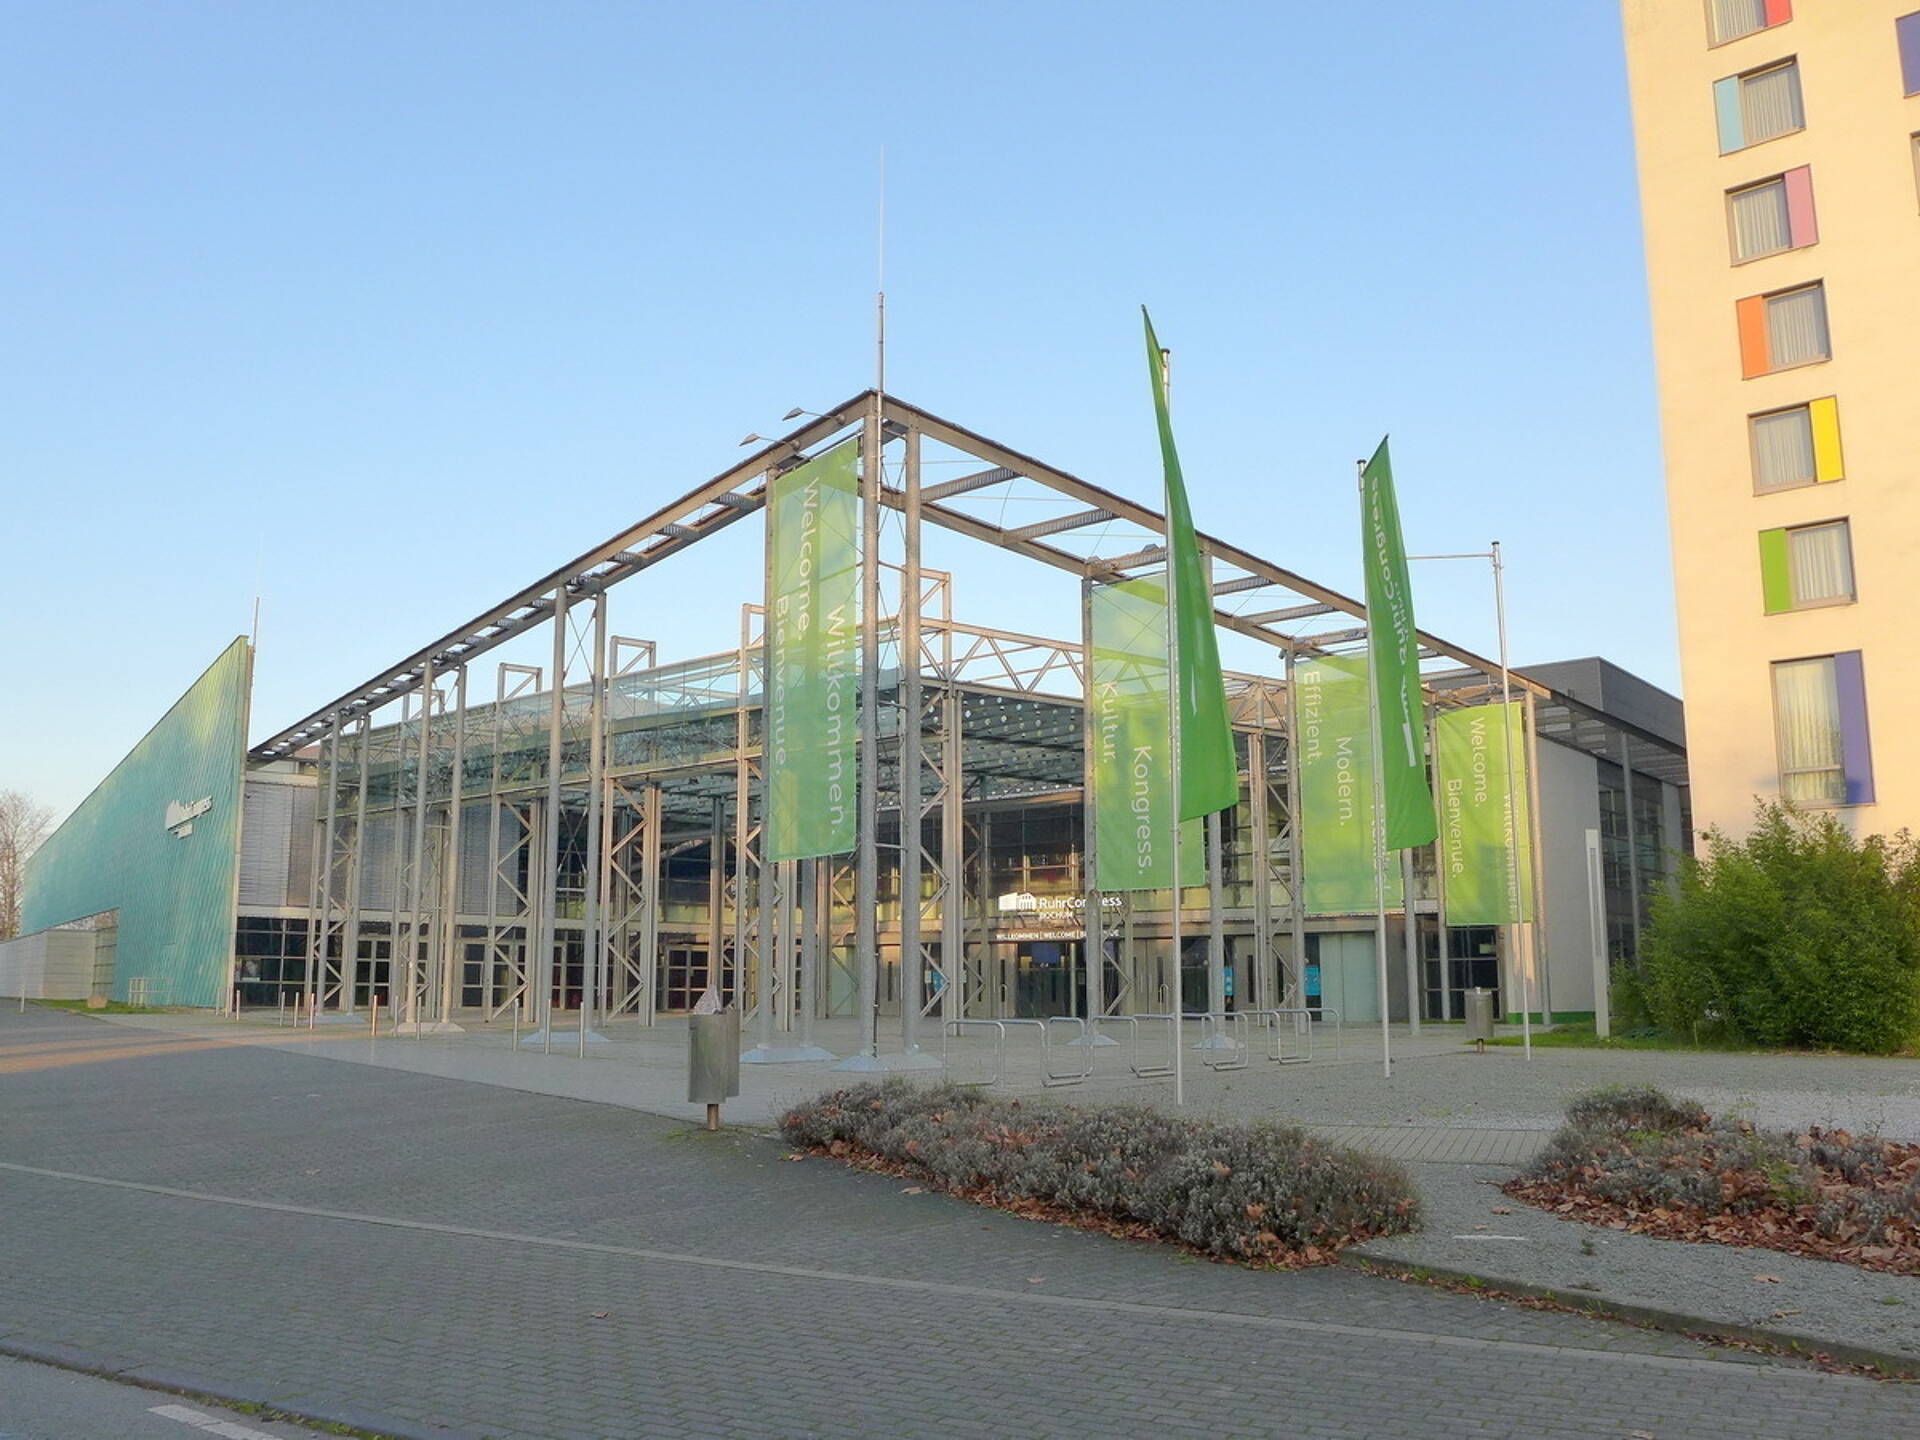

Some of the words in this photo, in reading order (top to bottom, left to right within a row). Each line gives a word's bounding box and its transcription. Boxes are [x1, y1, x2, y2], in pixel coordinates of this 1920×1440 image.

[798, 476, 819, 640] Welcome.
[775, 594, 788, 775] Bienvenue.
[826, 604, 845, 835] Willkommen.
[1102, 681, 1118, 763] Kultur.
[1303, 671, 1322, 765] Effizient.
[1131, 746, 1152, 875] Kongress.
[1336, 736, 1354, 826] Modern.
[1470, 716, 1487, 808] Welcome.
[1447, 778, 1464, 879] Bienvenue.
